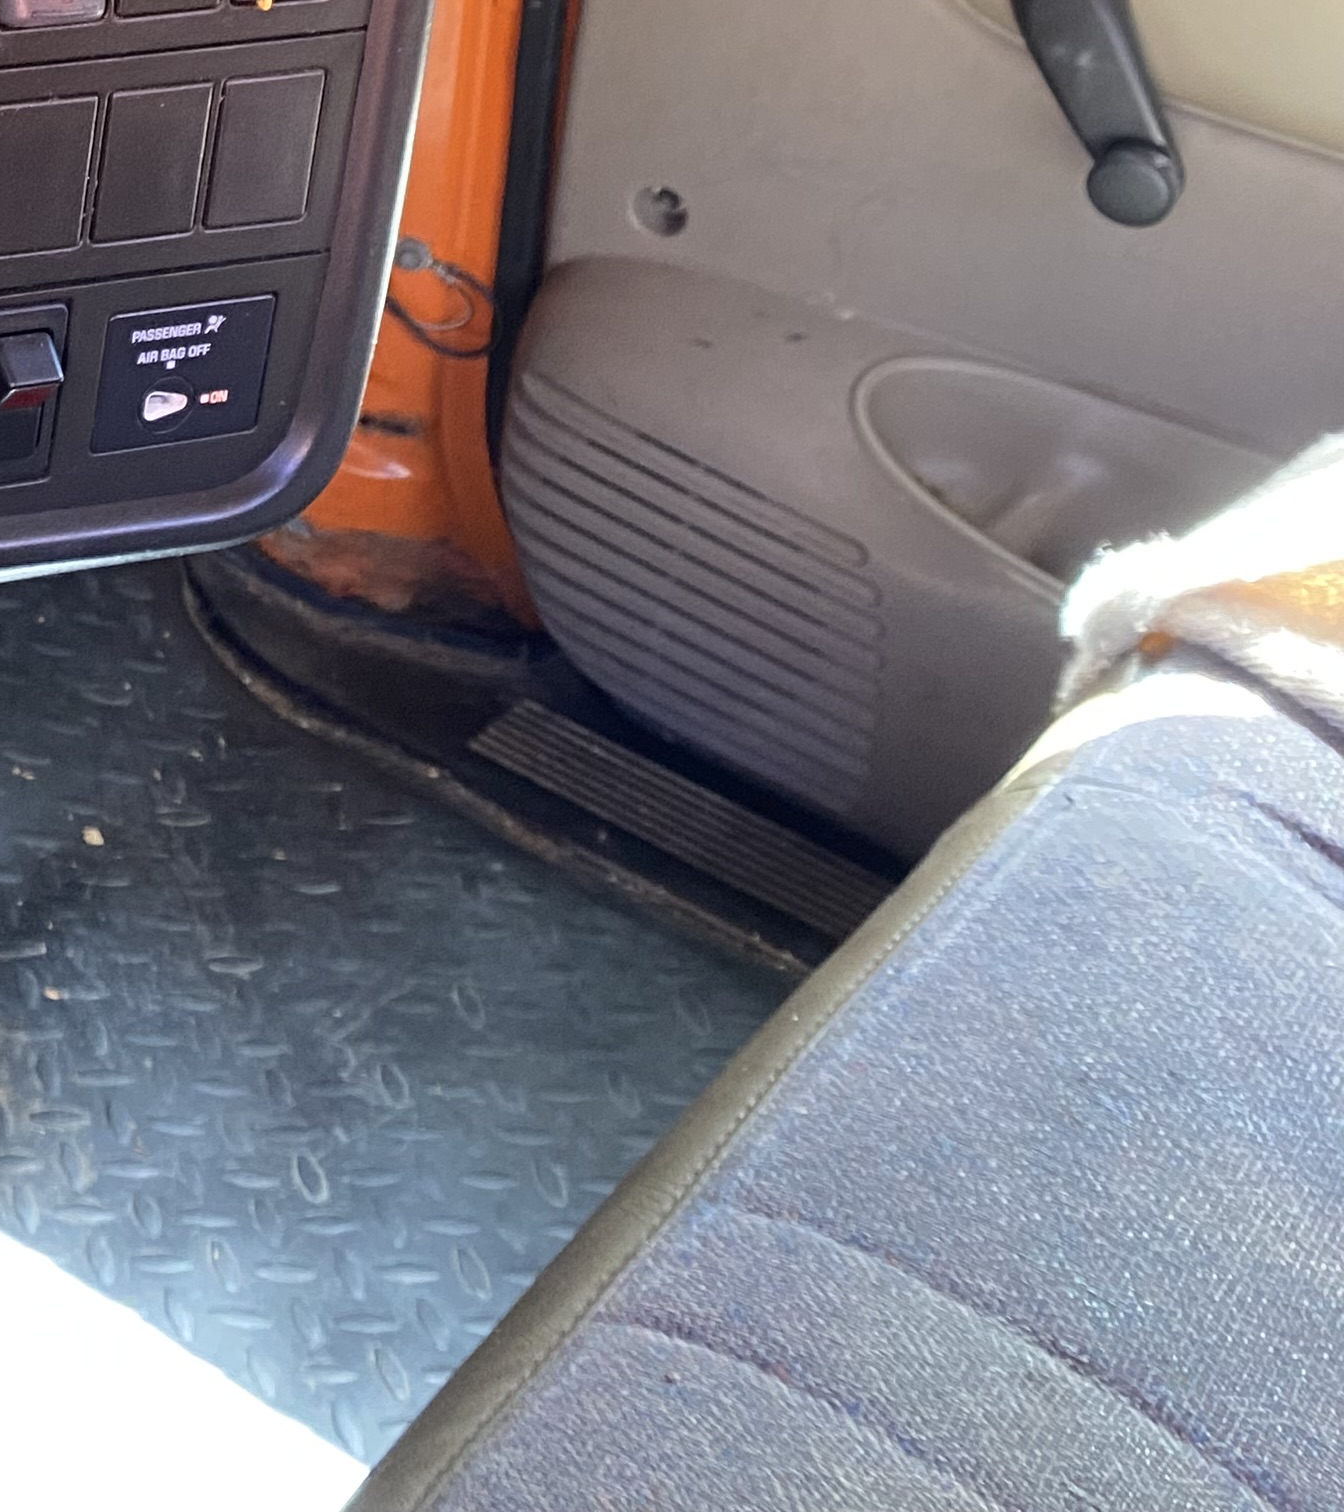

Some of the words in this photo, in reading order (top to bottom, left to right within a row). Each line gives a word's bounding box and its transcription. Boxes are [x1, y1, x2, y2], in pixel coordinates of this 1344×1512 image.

[131, 322, 202, 344] PASSENGER
[137, 350, 160, 365] AIR
[160, 347, 186, 362] BAG
[188, 343, 212, 358] OFF
[209, 389, 229, 404] ON
